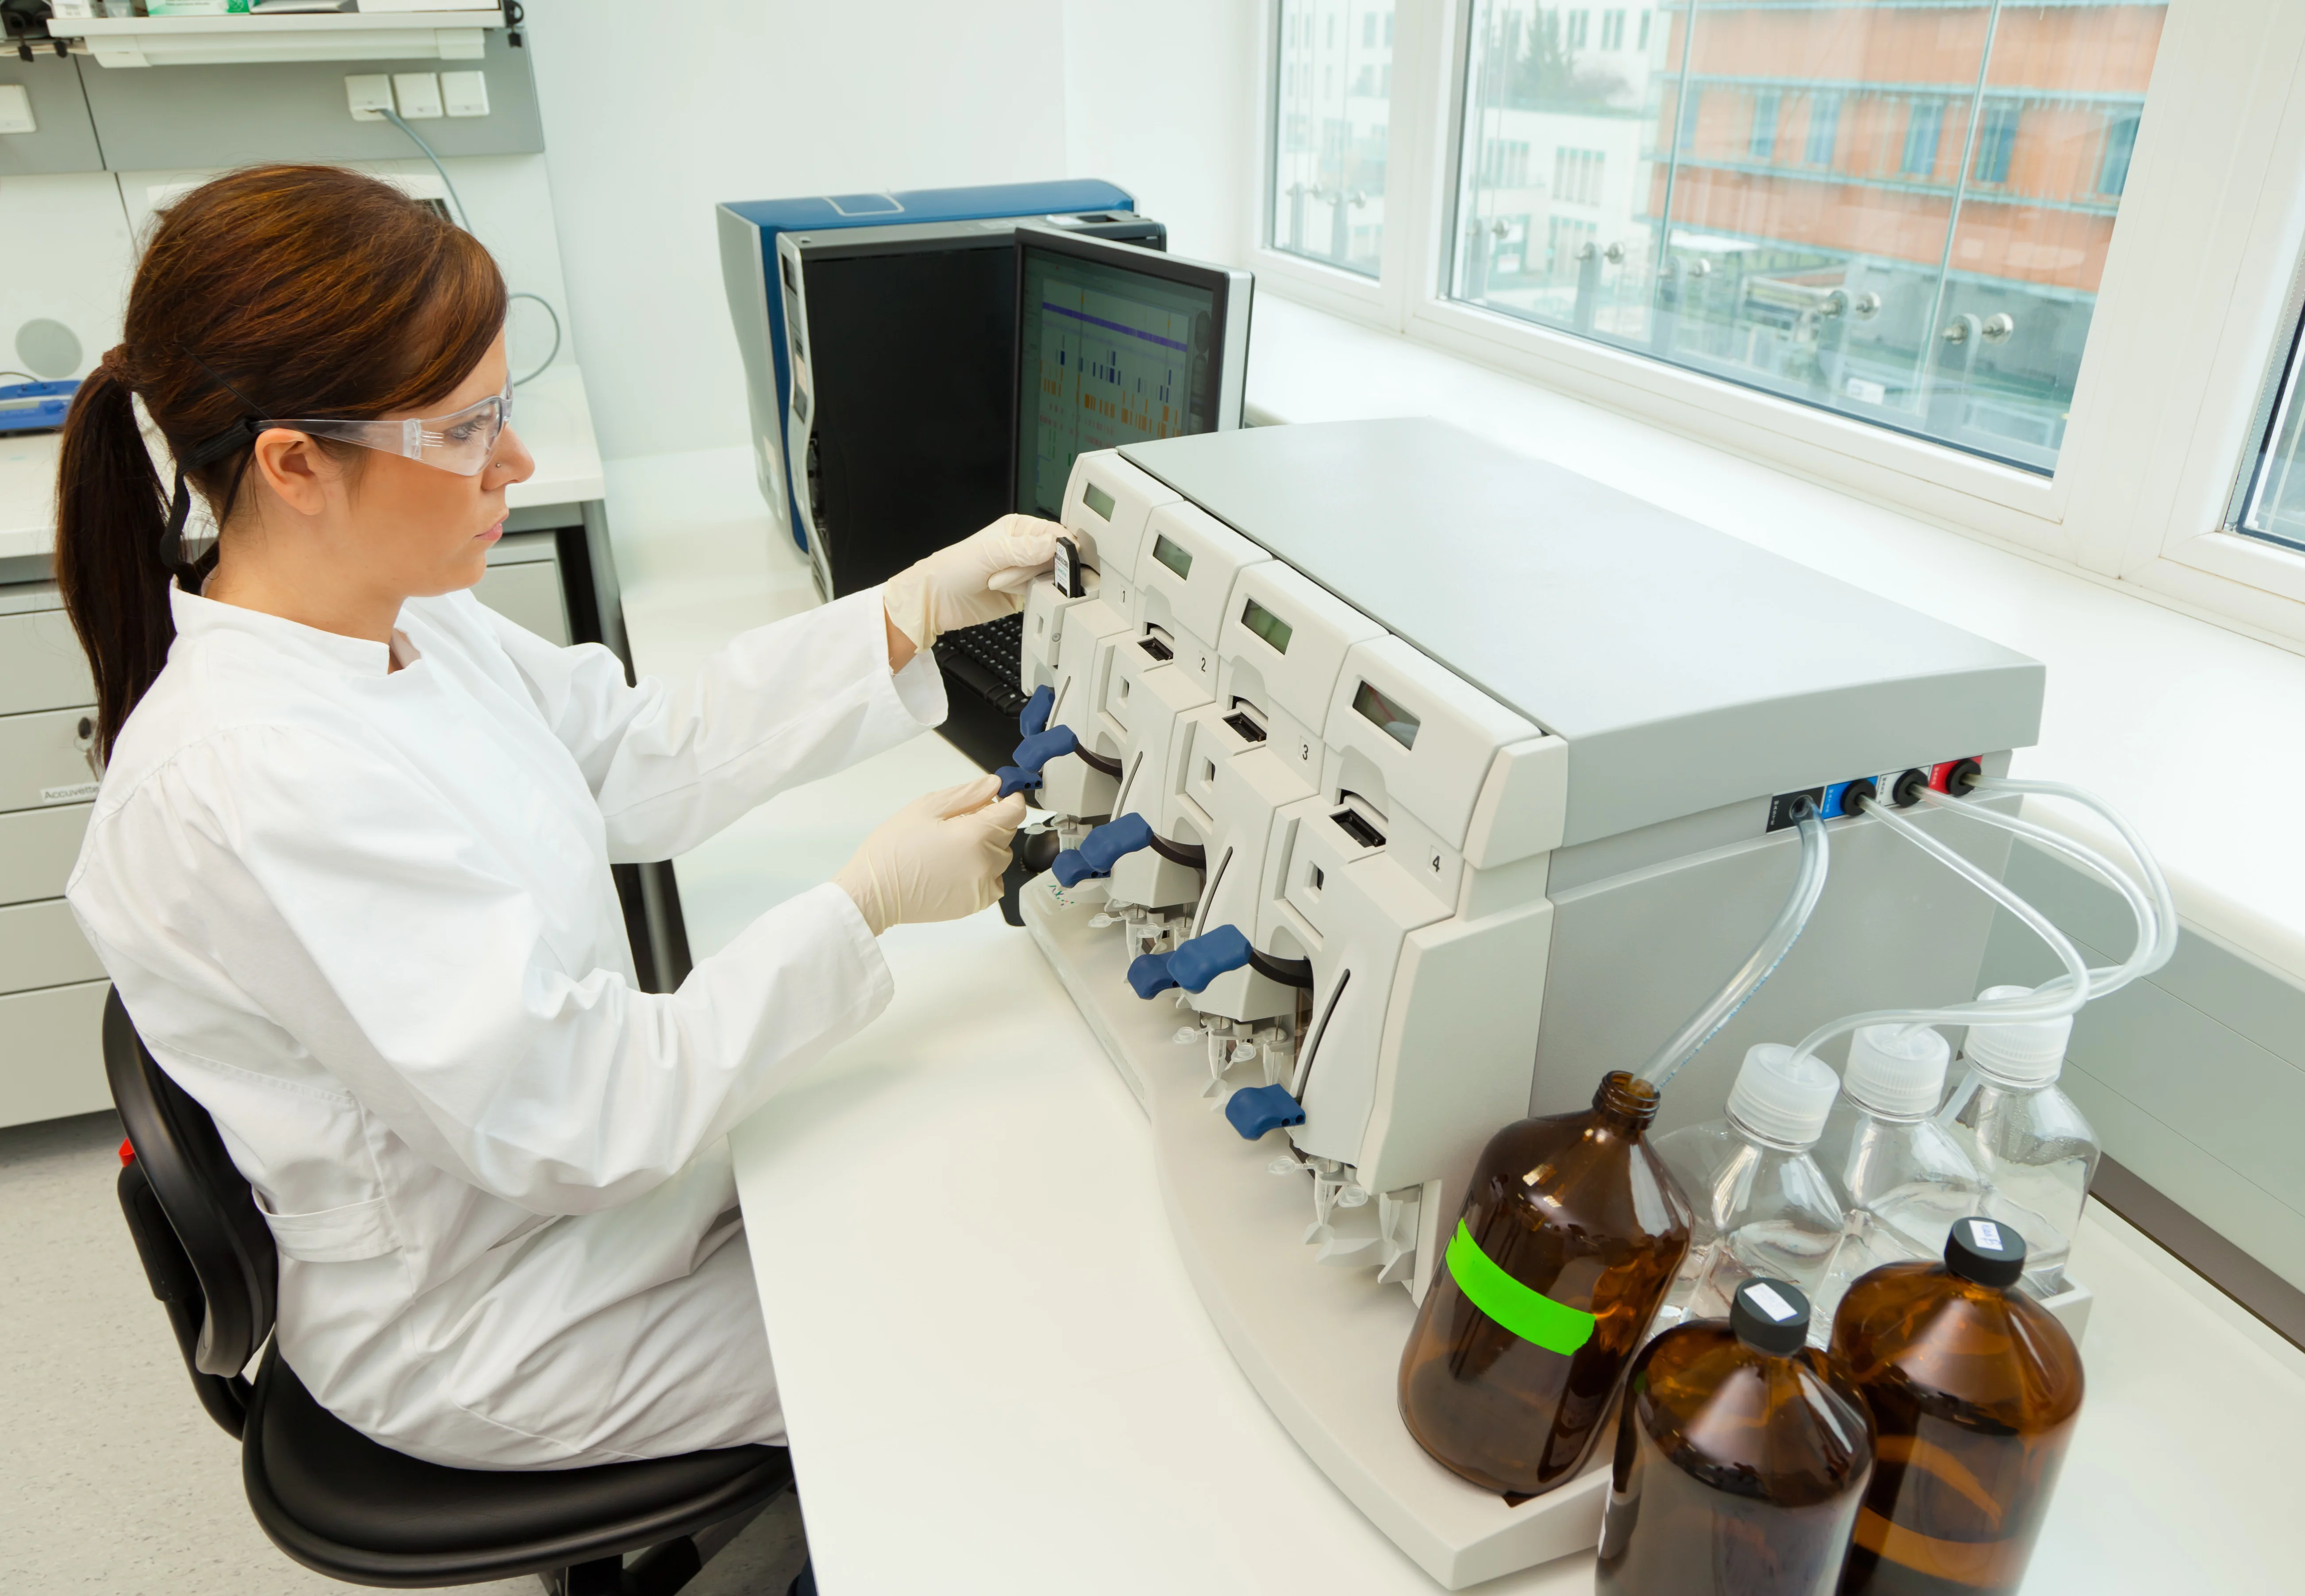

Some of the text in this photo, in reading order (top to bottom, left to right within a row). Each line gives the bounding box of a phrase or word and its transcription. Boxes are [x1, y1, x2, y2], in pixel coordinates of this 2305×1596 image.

[1122, 590, 1126, 602] 1
[1201, 657, 1206, 672] 2
[1302, 744, 1308, 760] 3
[1825, 789, 1834, 813] WATER
[1771, 800, 1779, 825] WASTE
[1432, 855, 1440, 872] 4
